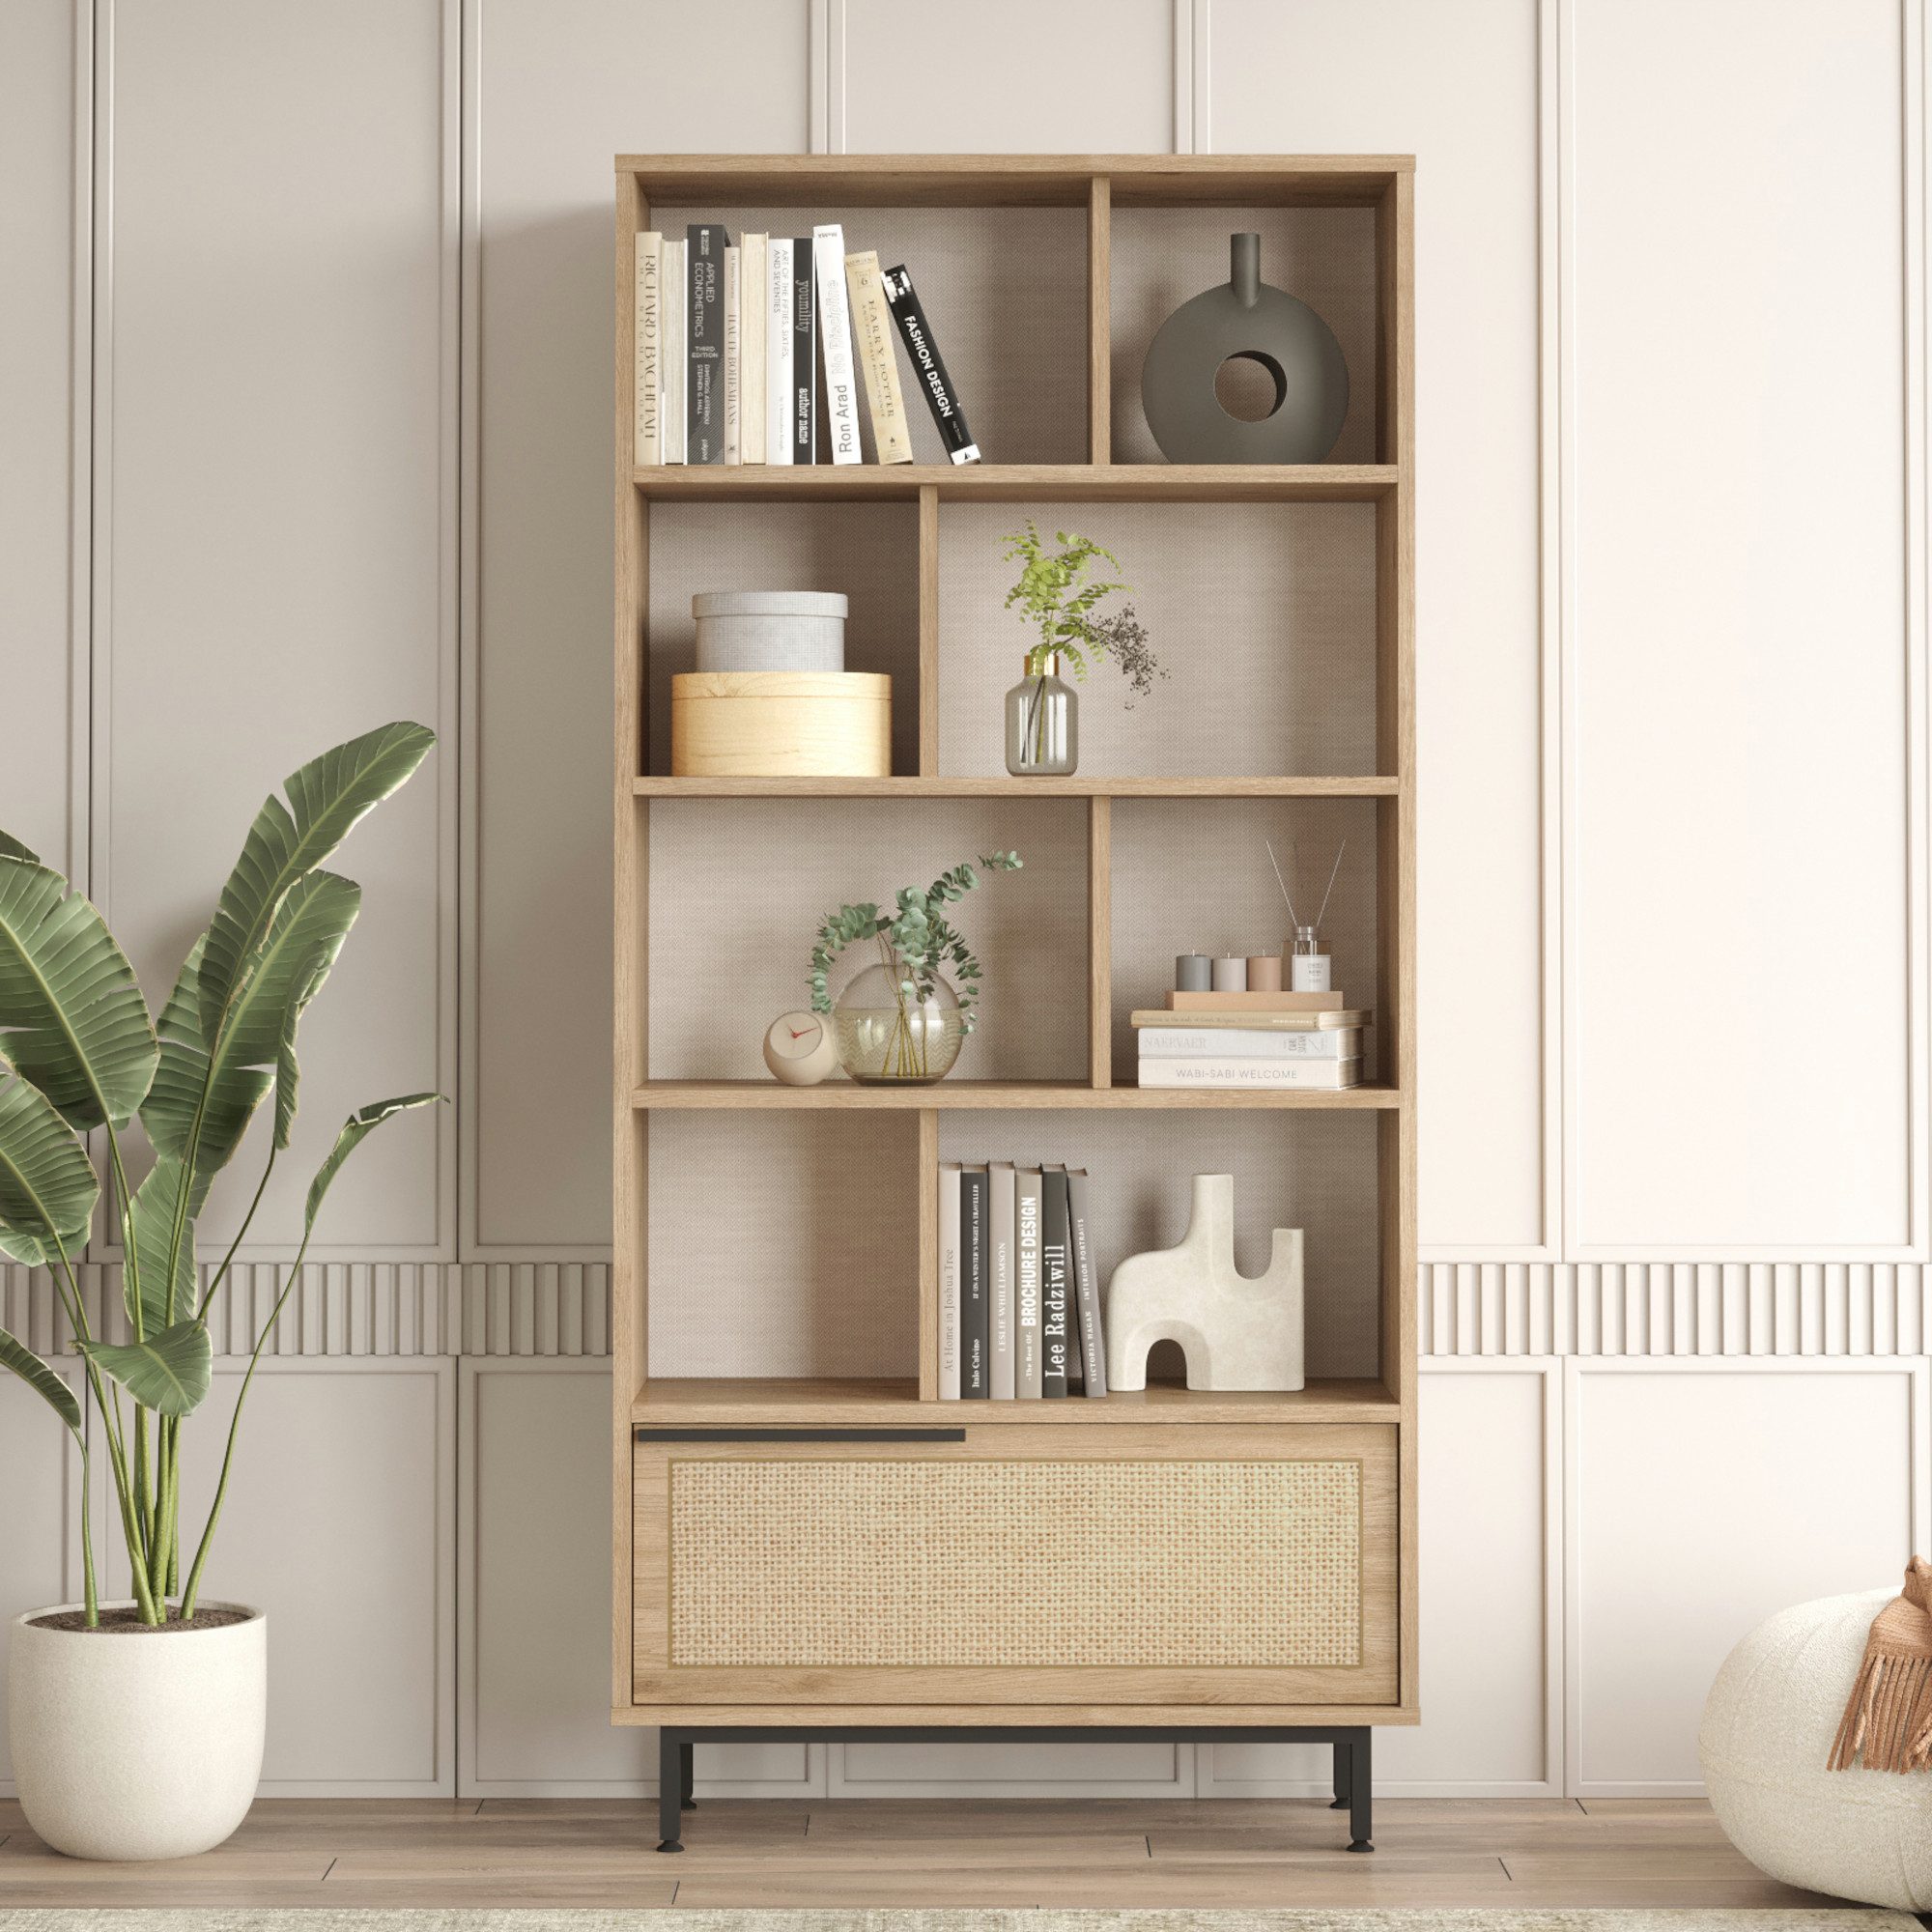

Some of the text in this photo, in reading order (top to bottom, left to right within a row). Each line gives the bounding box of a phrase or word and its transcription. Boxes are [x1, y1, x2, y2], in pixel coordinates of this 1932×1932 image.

[695, 262, 704, 338] ECONOMETRICS
[706, 262, 715, 302] APPLIED
[773, 249, 781, 314] AND SEVENTIES
[781, 268, 789, 280] OF
[781, 282, 789, 297] THE
[795, 280, 811, 333] youmility
[645, 255, 657, 440] RICHARD BACHMAN
[727, 314, 737, 425] HAUTE BOHEMIANS
[831, 354, 846, 375] No
[867, 300, 895, 417] HARRY POTTER
[904, 315, 953, 417] FASHION DESIGN
[799, 387, 810, 444] author name
[835, 385, 853, 453] Ron Arad
[1176, 1068, 1297, 1079] WABI-SABI WELCOME
[1021, 1197, 1037, 1327] BROCHURE DESIGN
[1077, 1218, 1090, 1300] INTERIOR PORTRAITS
[944, 1249, 955, 1373] At Home in Joshua Tree
[1044, 1244, 1065, 1378] Lee Radziwill
[972, 1338, 980, 1388] Italo Calvino
[1085, 1311, 1097, 1383] VICTORIA HAGAN
